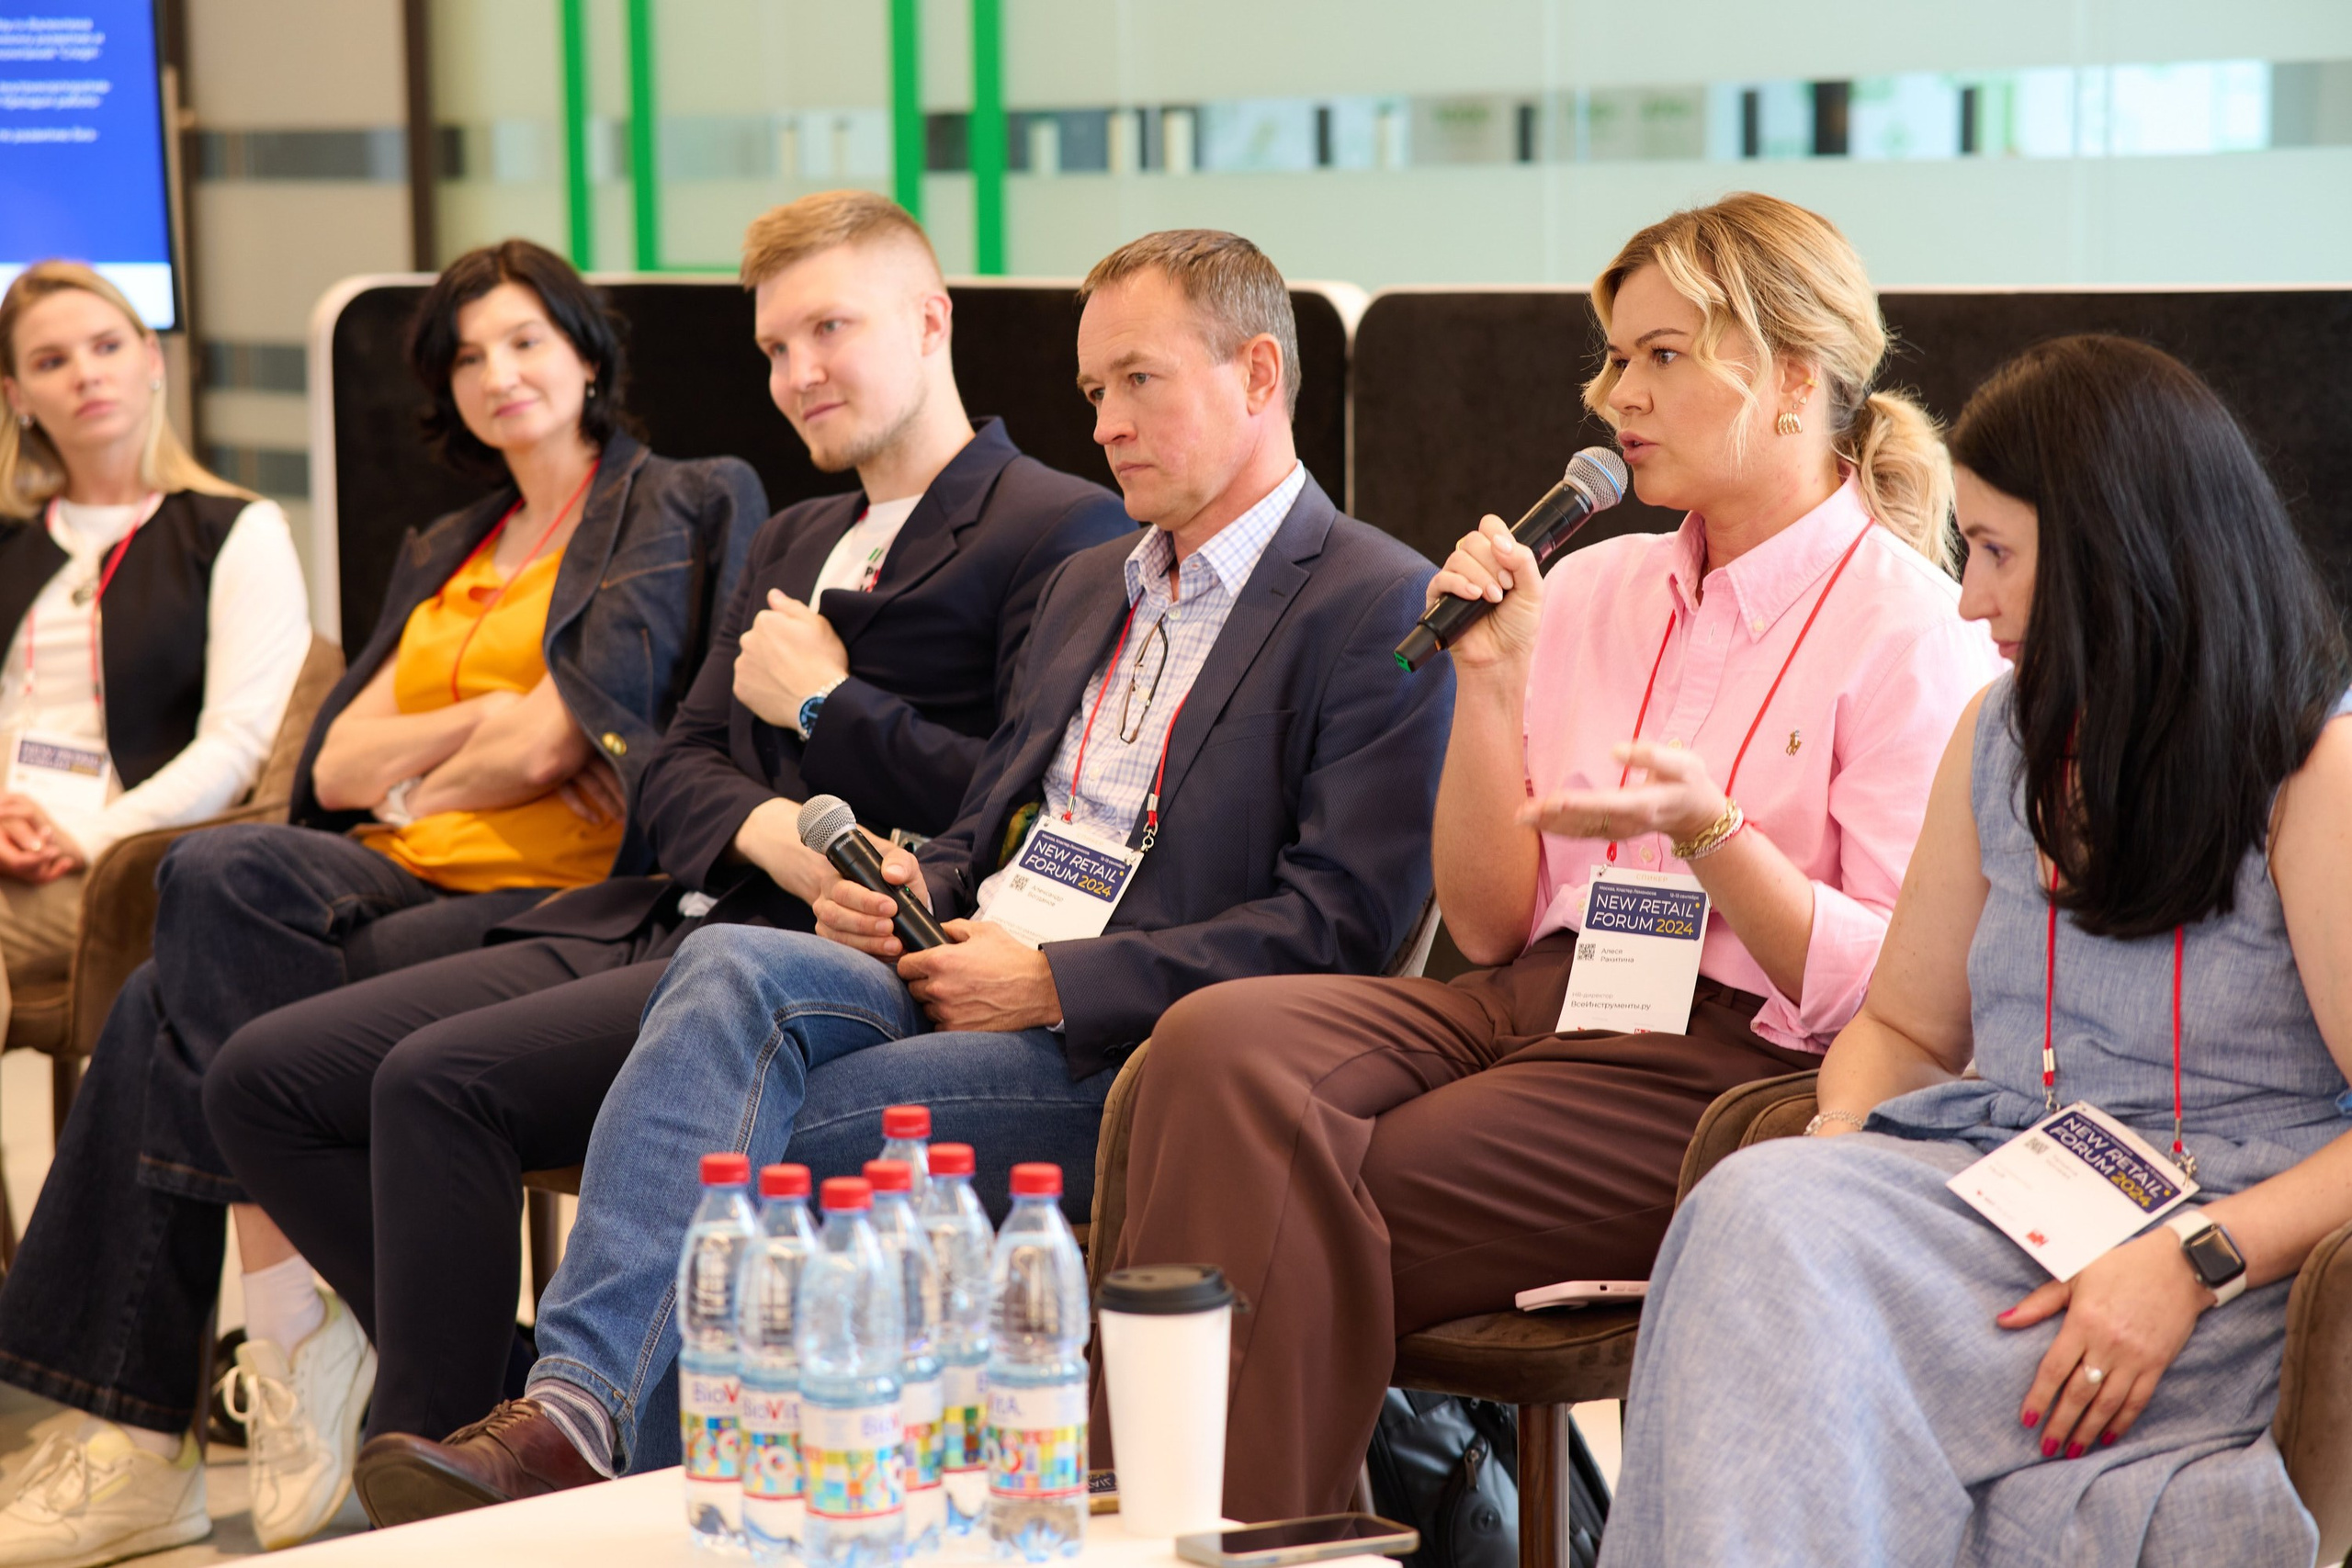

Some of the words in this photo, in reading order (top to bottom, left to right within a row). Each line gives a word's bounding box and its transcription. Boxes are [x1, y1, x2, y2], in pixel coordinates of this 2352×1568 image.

[1024, 854, 1080, 884] FORUM
[1078, 874, 1113, 897] 2024
[1034, 840, 1071, 863] NEW
[1069, 854, 1117, 884] RETAIL
[1596, 894, 1636, 911] NEW
[1639, 898, 1694, 918] RETAIL
[1592, 911, 1654, 931] FORUM
[1656, 919, 1693, 936] 2024
[1571, 1000, 1652, 1011] ВсеИнструменты.ру
[2049, 1125, 2116, 1176] FORUM
[2109, 1170, 2153, 1207] 2024
[2063, 1117, 2109, 1150] NEW
[2105, 1148, 2163, 1199] RETAIL
[695, 1382, 740, 1404] BioV
